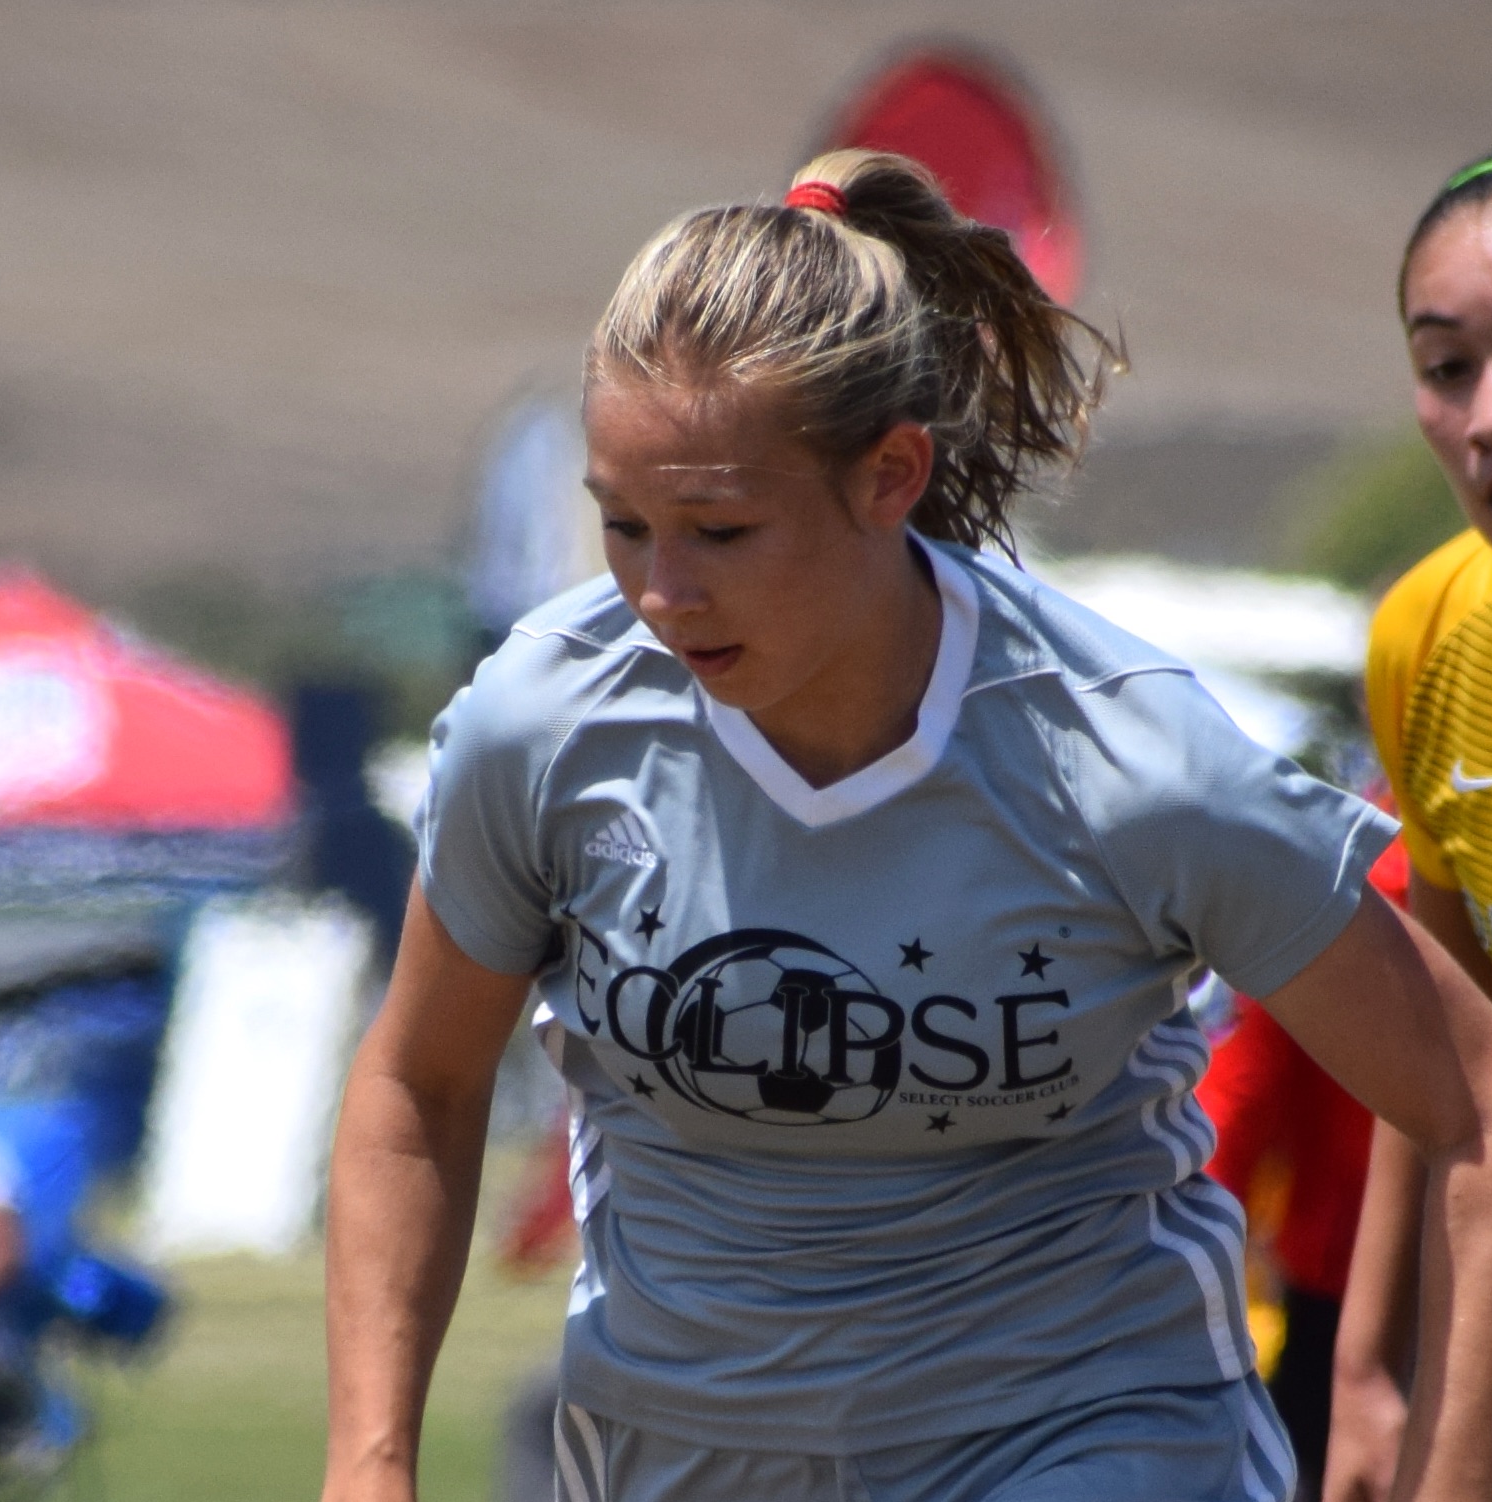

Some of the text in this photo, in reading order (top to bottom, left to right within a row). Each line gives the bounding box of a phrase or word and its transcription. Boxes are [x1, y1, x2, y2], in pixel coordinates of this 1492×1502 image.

[584, 842, 657, 869] adidas
[563, 914, 1073, 1093] ECLIPSE
[899, 1075, 1080, 1107] SELECT SOCCER CLUB
